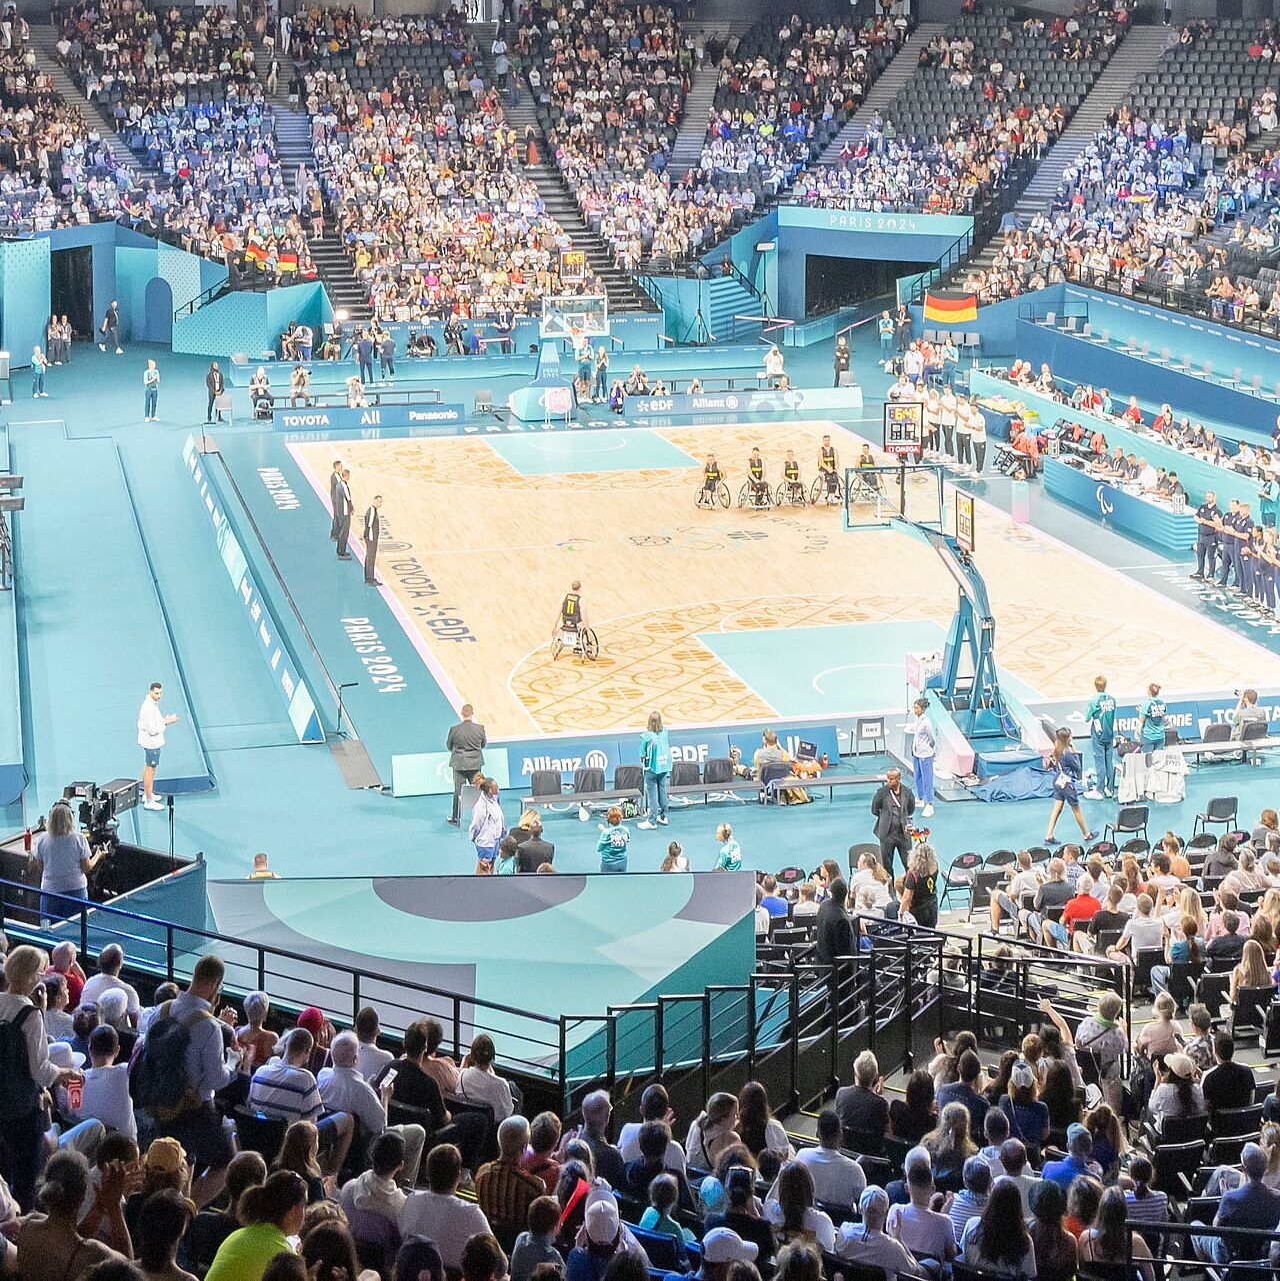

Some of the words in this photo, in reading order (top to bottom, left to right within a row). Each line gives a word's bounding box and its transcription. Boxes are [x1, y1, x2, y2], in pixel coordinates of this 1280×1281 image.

[830, 216, 872, 228] PARIS
[877, 219, 918, 230] 2024
[693, 398, 725, 409] Allianz
[283, 415, 330, 426] TOYOTA
[408, 410, 458, 421] Panasonic
[388, 557, 440, 598] TOYOTA
[521, 756, 582, 775] Allianz
